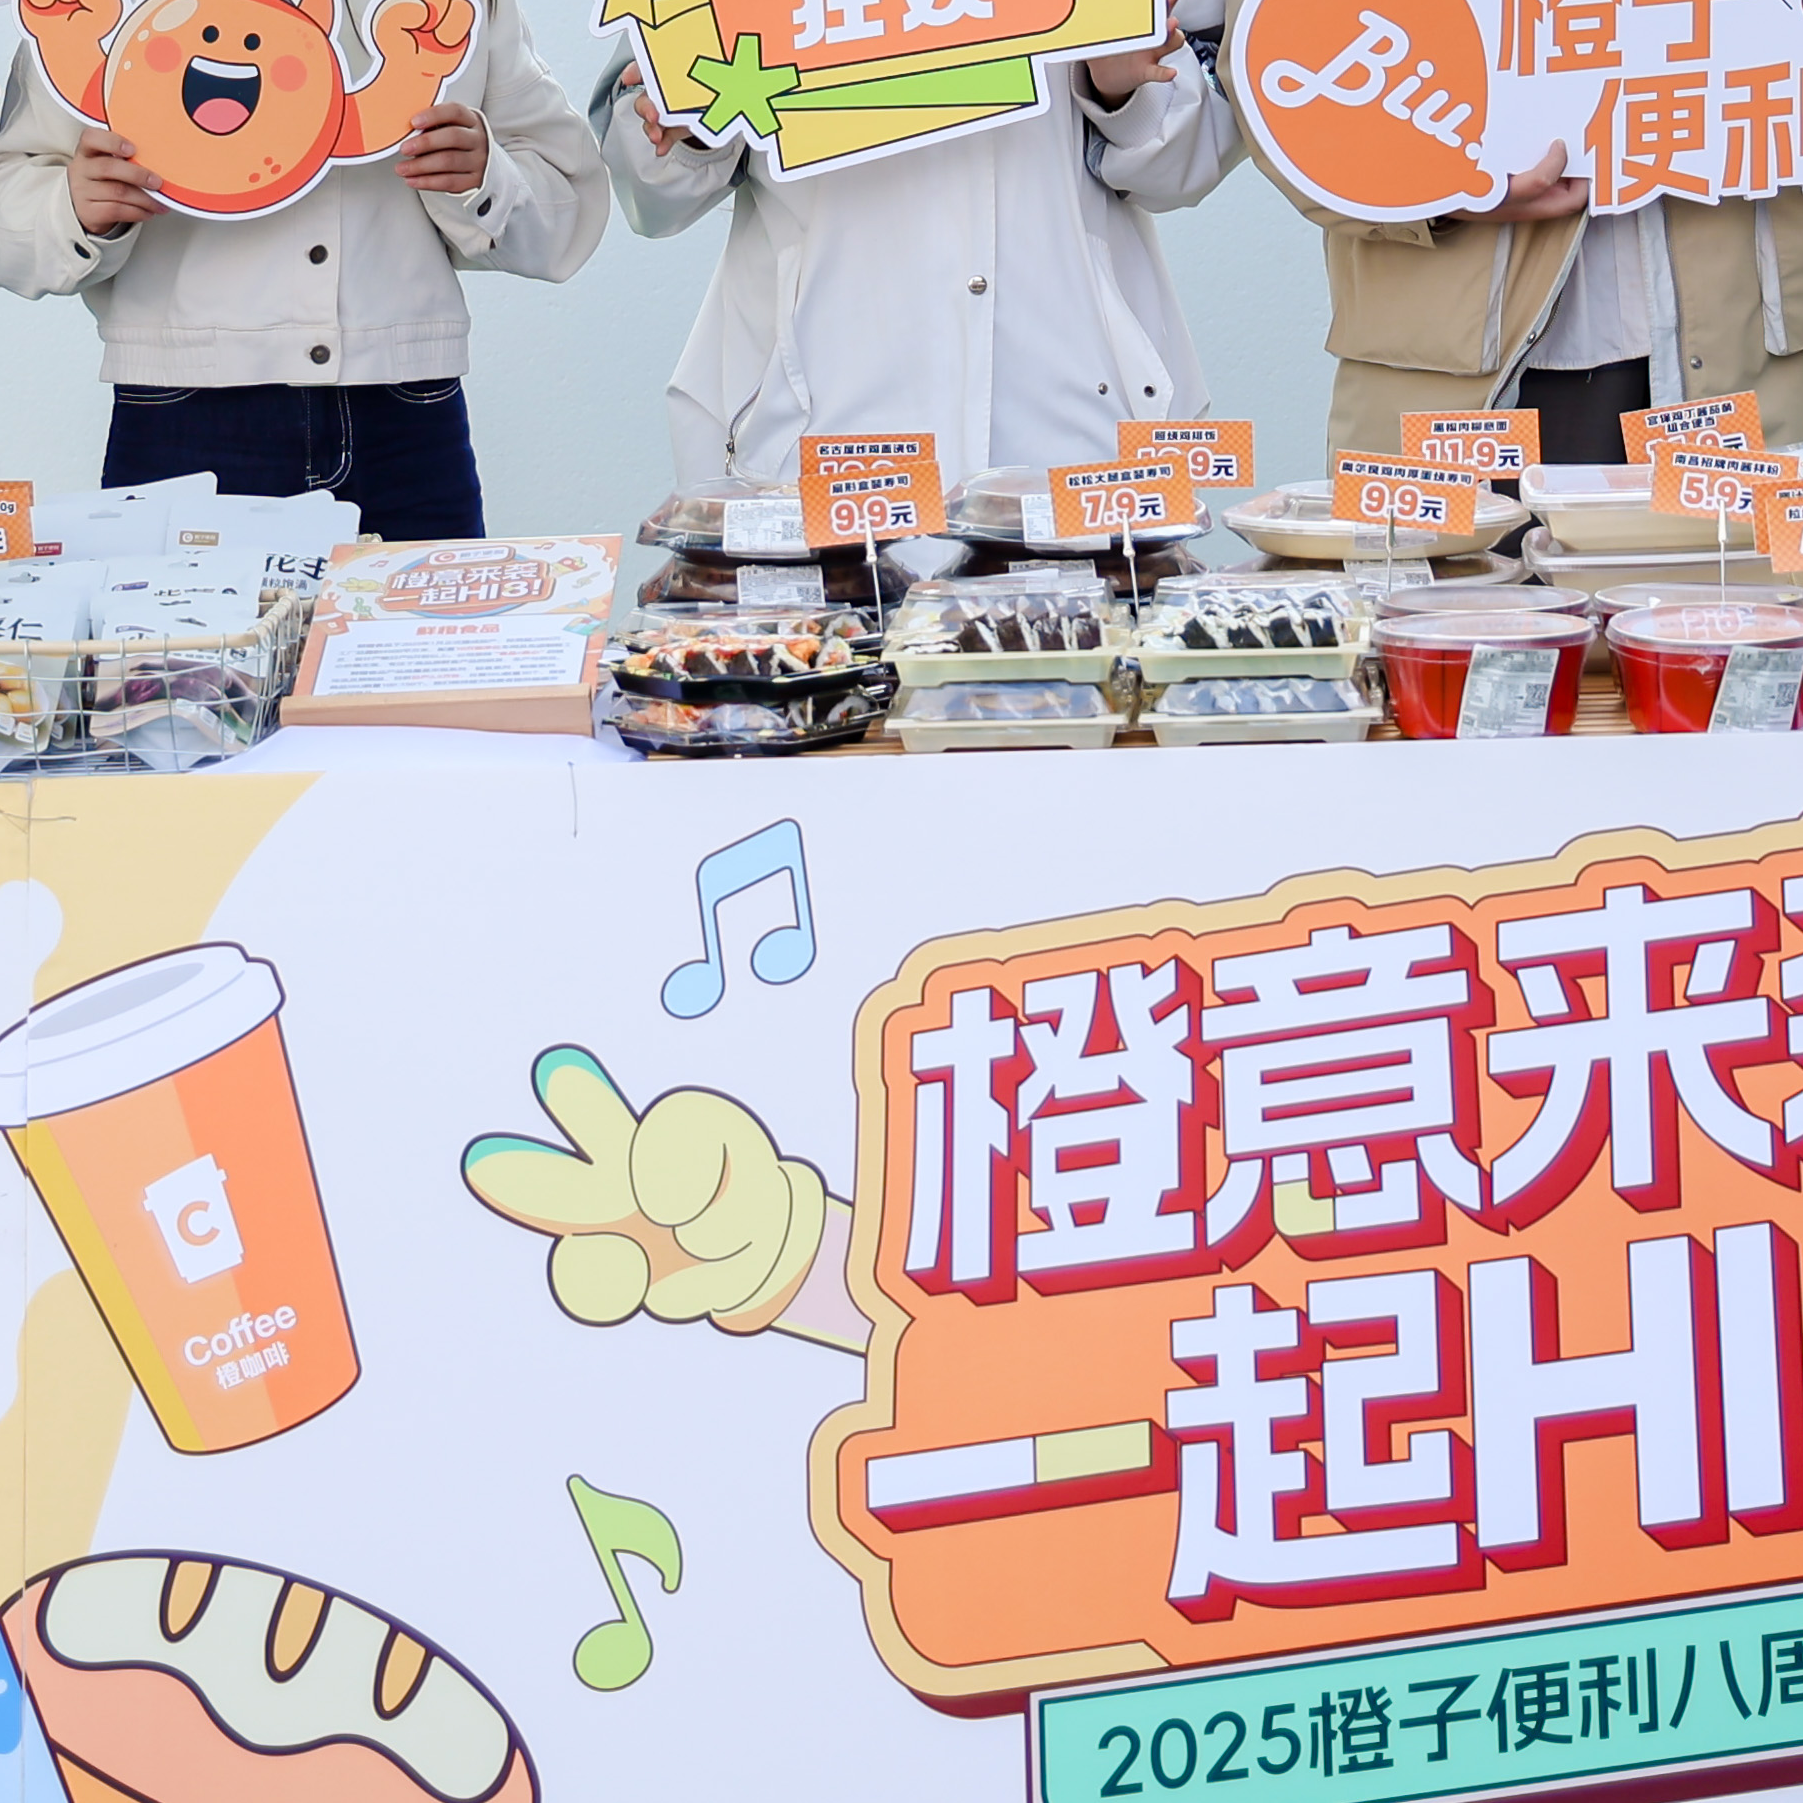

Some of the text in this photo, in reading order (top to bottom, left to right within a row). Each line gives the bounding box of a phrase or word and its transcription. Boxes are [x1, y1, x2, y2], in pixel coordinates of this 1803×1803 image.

[830, 496, 918, 535] 9.9元
[1080, 488, 1165, 527] 7.9元
[1361, 481, 1447, 523] 9.9元
[391, 561, 540, 589] 橙意来袭
[182, 1303, 299, 1368] Coffee
[214, 1341, 291, 1391] 橙咖啡
